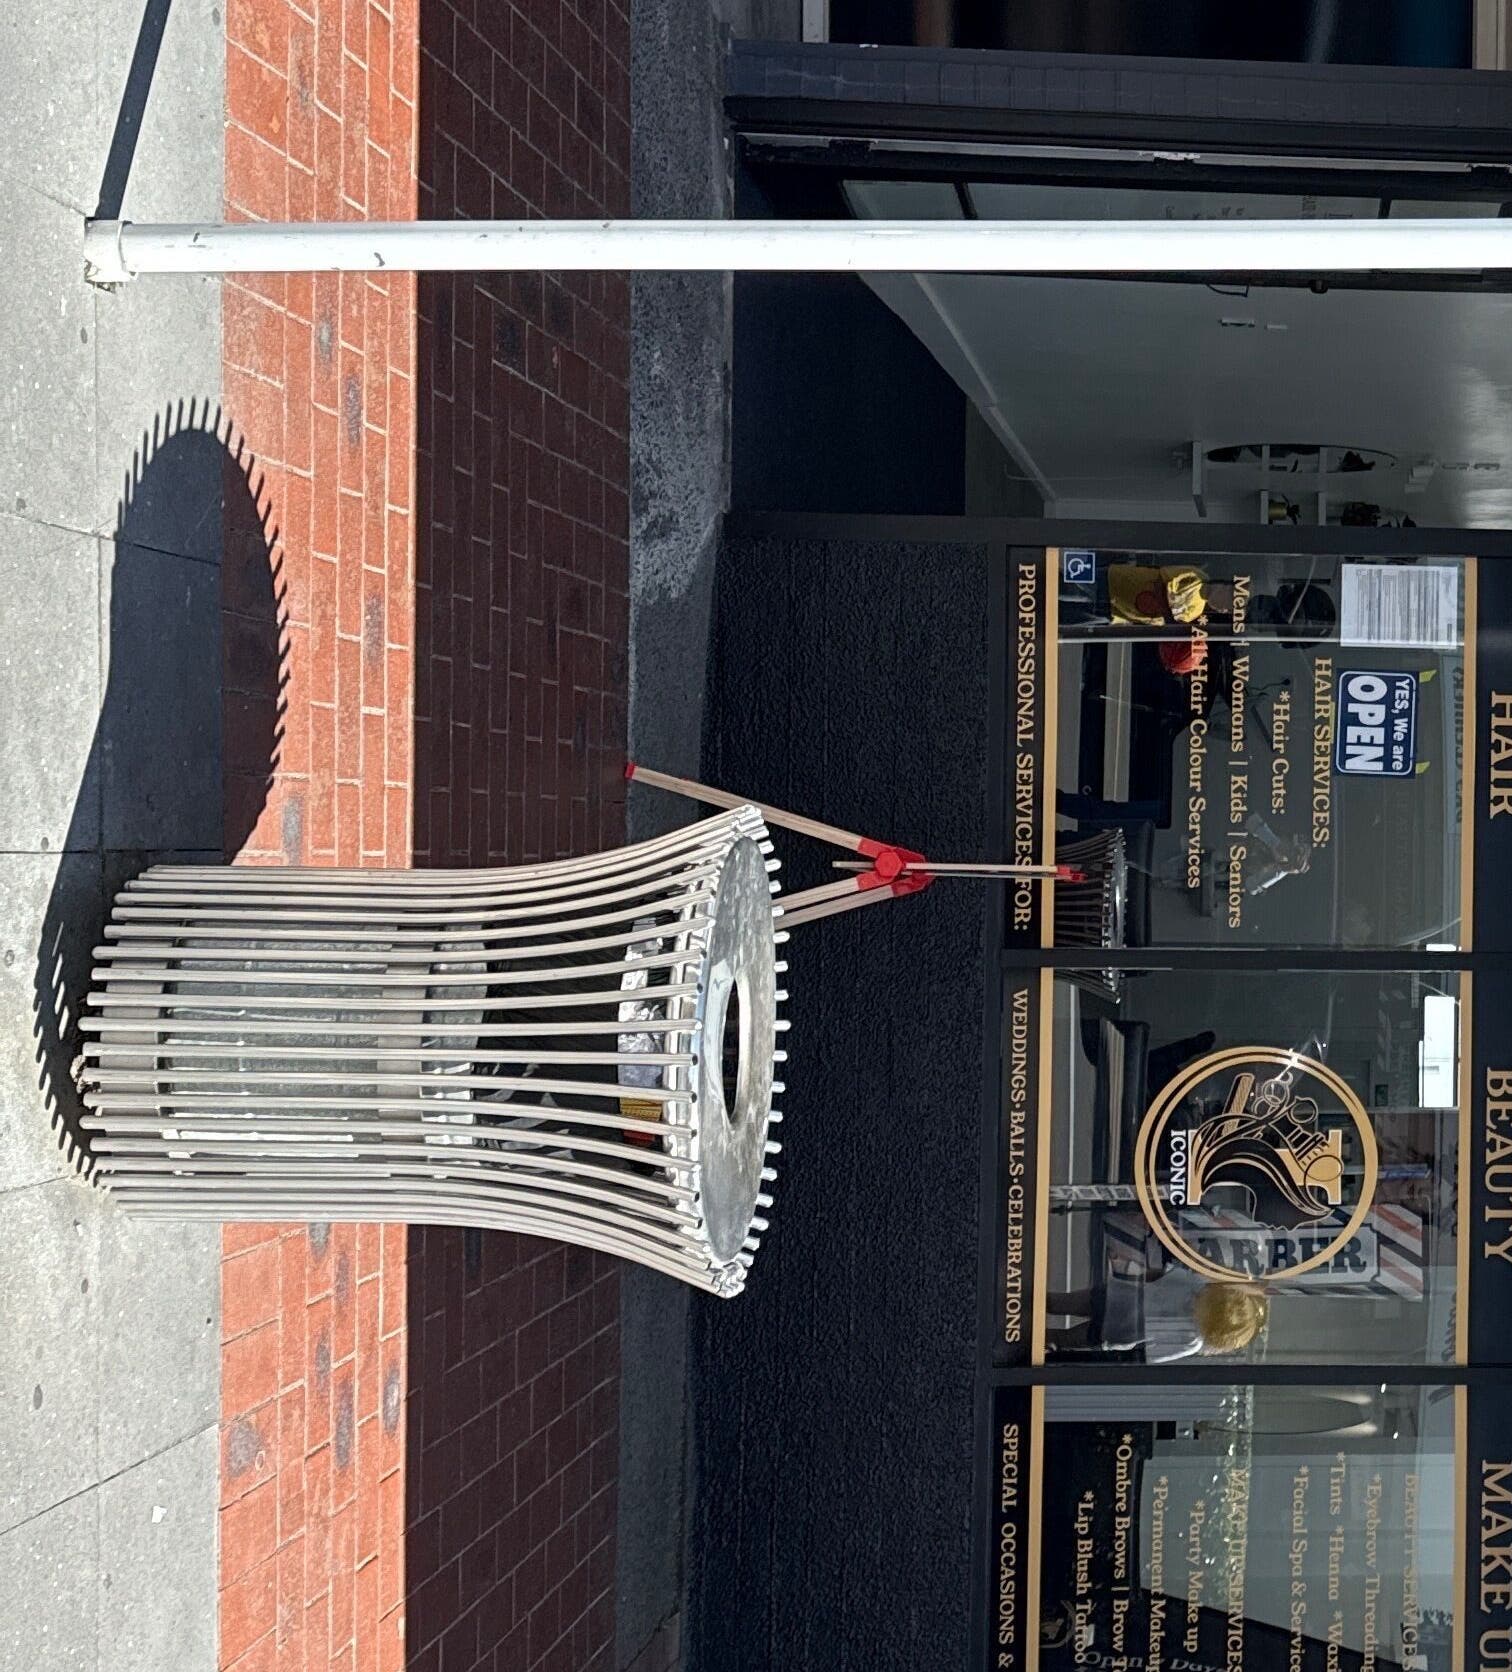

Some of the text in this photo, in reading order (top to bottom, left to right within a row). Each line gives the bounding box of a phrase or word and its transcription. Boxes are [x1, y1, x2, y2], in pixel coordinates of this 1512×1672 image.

[1231, 575, 1249, 633] Mens
[1190, 664, 1207, 714] Hair
[1230, 655, 1248, 753] Womans
[1391, 678, 1409, 713] YES,
[1014, 564, 1035, 931] PROFESSIONAL SERVICES FOR:
[1312, 657, 1331, 849] HAIR SERVICES:
[1345, 675, 1385, 770] OPEN
[1394, 718, 1408, 741] We
[1189, 719, 1207, 793] Colour
[1271, 758, 1288, 815] Cuts:
[1390, 745, 1407, 770] are
[1229, 775, 1247, 823] Kids
[1187, 797, 1206, 888] Services
[1228, 845, 1246, 928] Seniors
[1169, 1129, 1186, 1205] ICONIC
[1229, 1468, 1246, 1532] MAKE
[999, 1423, 1019, 1667] SPECIAL OCCASIONS &
[1076, 1539, 1093, 1594] Blush
[1113, 1516, 1130, 1578] Brows
[1289, 1539, 1307, 1576] Spa
[1402, 1473, 1419, 1669] BEAUTY SERVICES
[1187, 1571, 1203, 1622] Make
[1292, 1581, 1306, 1596] &
[1074, 1600, 1091, 1663] Tattoo
[1113, 1599, 1129, 1651] Brow
[1147, 1599, 1166, 1672] Makeup
[1183, 1626, 1199, 1652] up
[1227, 1573, 1244, 1672] SERVICES
[1361, 1574, 1381, 1672] Threading
[1112, 1655, 1129, 1672] T
